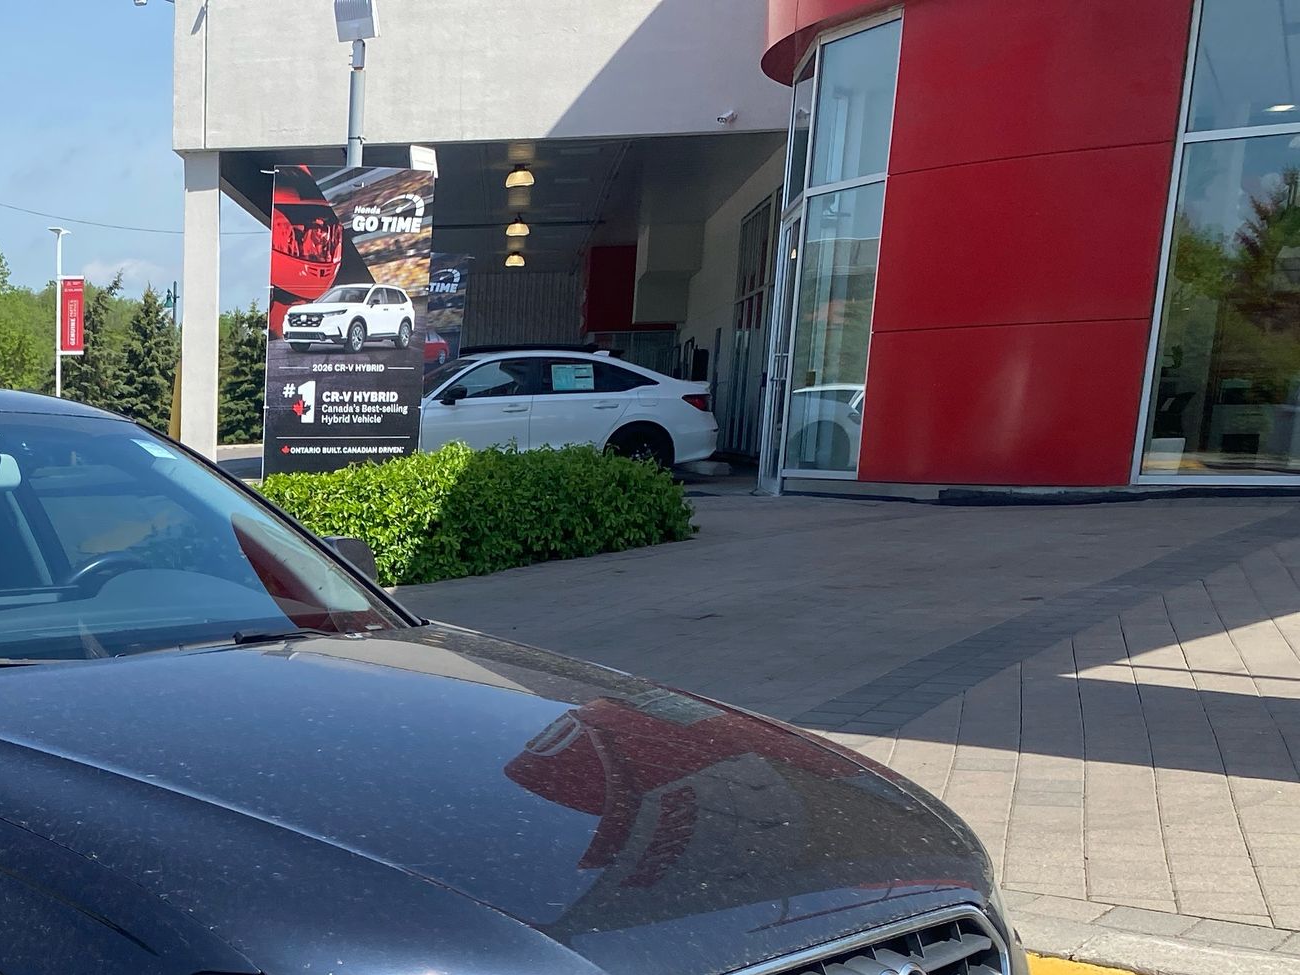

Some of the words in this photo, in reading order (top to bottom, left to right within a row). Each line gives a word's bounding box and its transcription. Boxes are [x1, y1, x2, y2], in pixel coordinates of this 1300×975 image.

[354, 205, 381, 214] Honda
[352, 215, 379, 232] GO
[381, 216, 423, 233] TIME
[429, 282, 459, 293] TIME
[312, 363, 333, 372] 2026
[334, 364, 355, 372] CR-V
[355, 364, 385, 372] HYBRID
[322, 391, 352, 403] CR-V
[353, 391, 399, 403] HYBRID
[321, 404, 359, 413] Canada's
[361, 404, 408, 415] Best-selling
[321, 414, 351, 425] Hybrid
[290, 446, 321, 454] ONTARIO
[322, 446, 342, 454] BUILT.
[342, 446, 378, 454] CANADIAN
